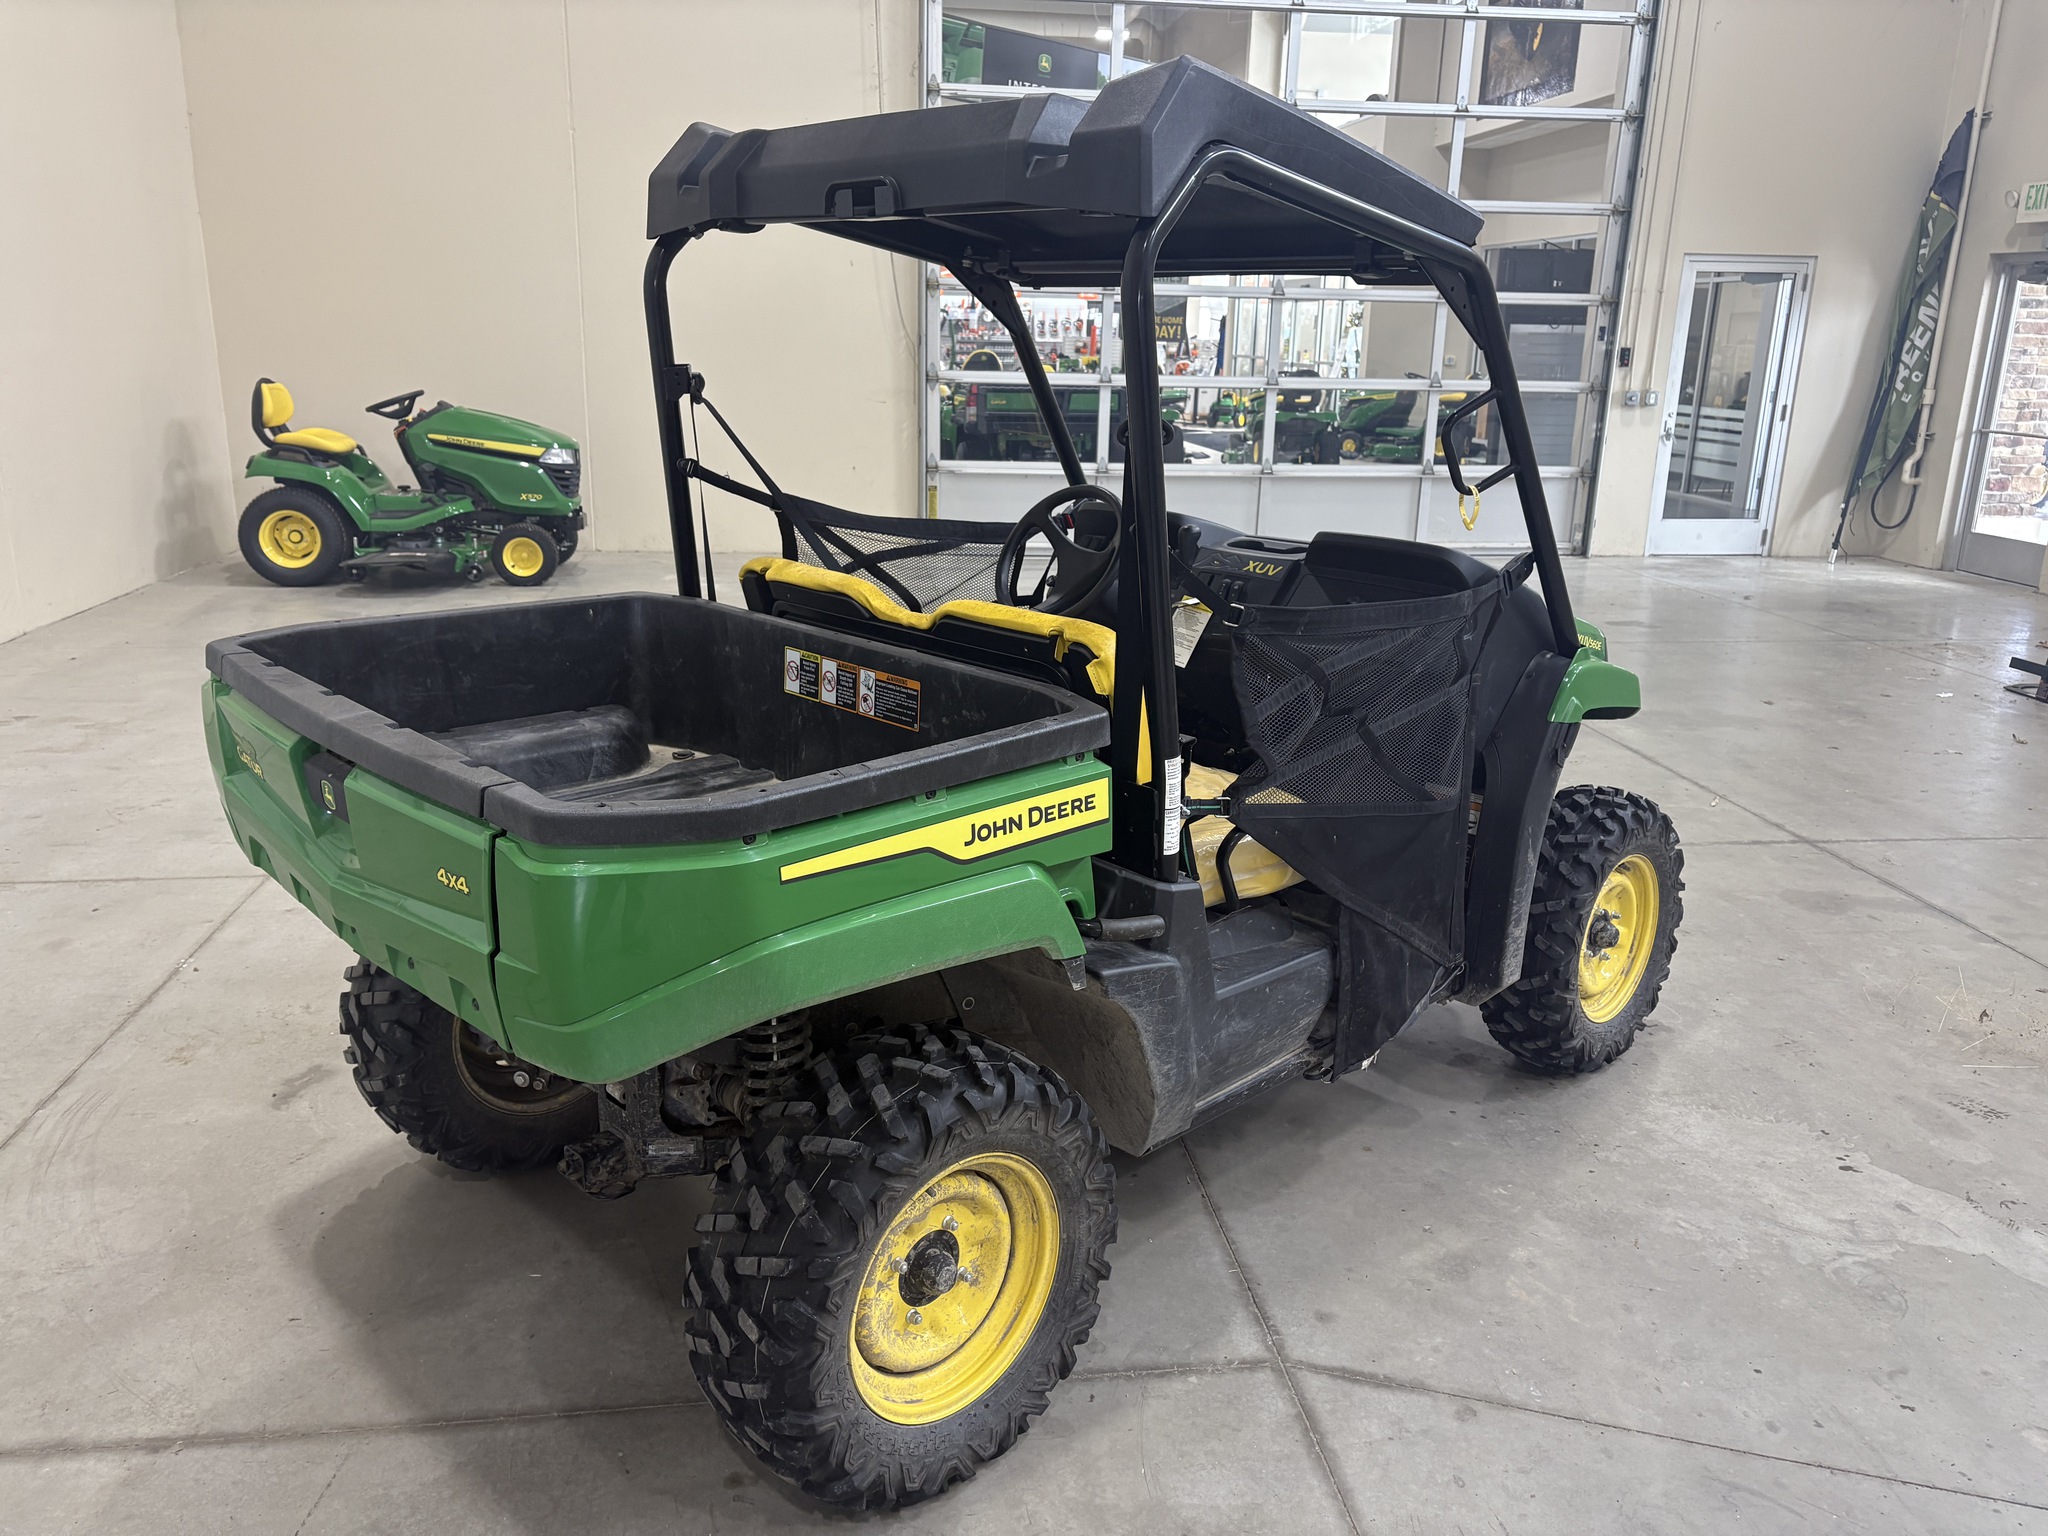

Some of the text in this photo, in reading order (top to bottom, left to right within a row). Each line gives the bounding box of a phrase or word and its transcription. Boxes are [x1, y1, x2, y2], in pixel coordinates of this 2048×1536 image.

[1162, 316, 1184, 325] HOME
[463, 438, 485, 447] DEERE
[1242, 560, 1283, 576] XUV
[964, 793, 1096, 847] JOHN DEERE
